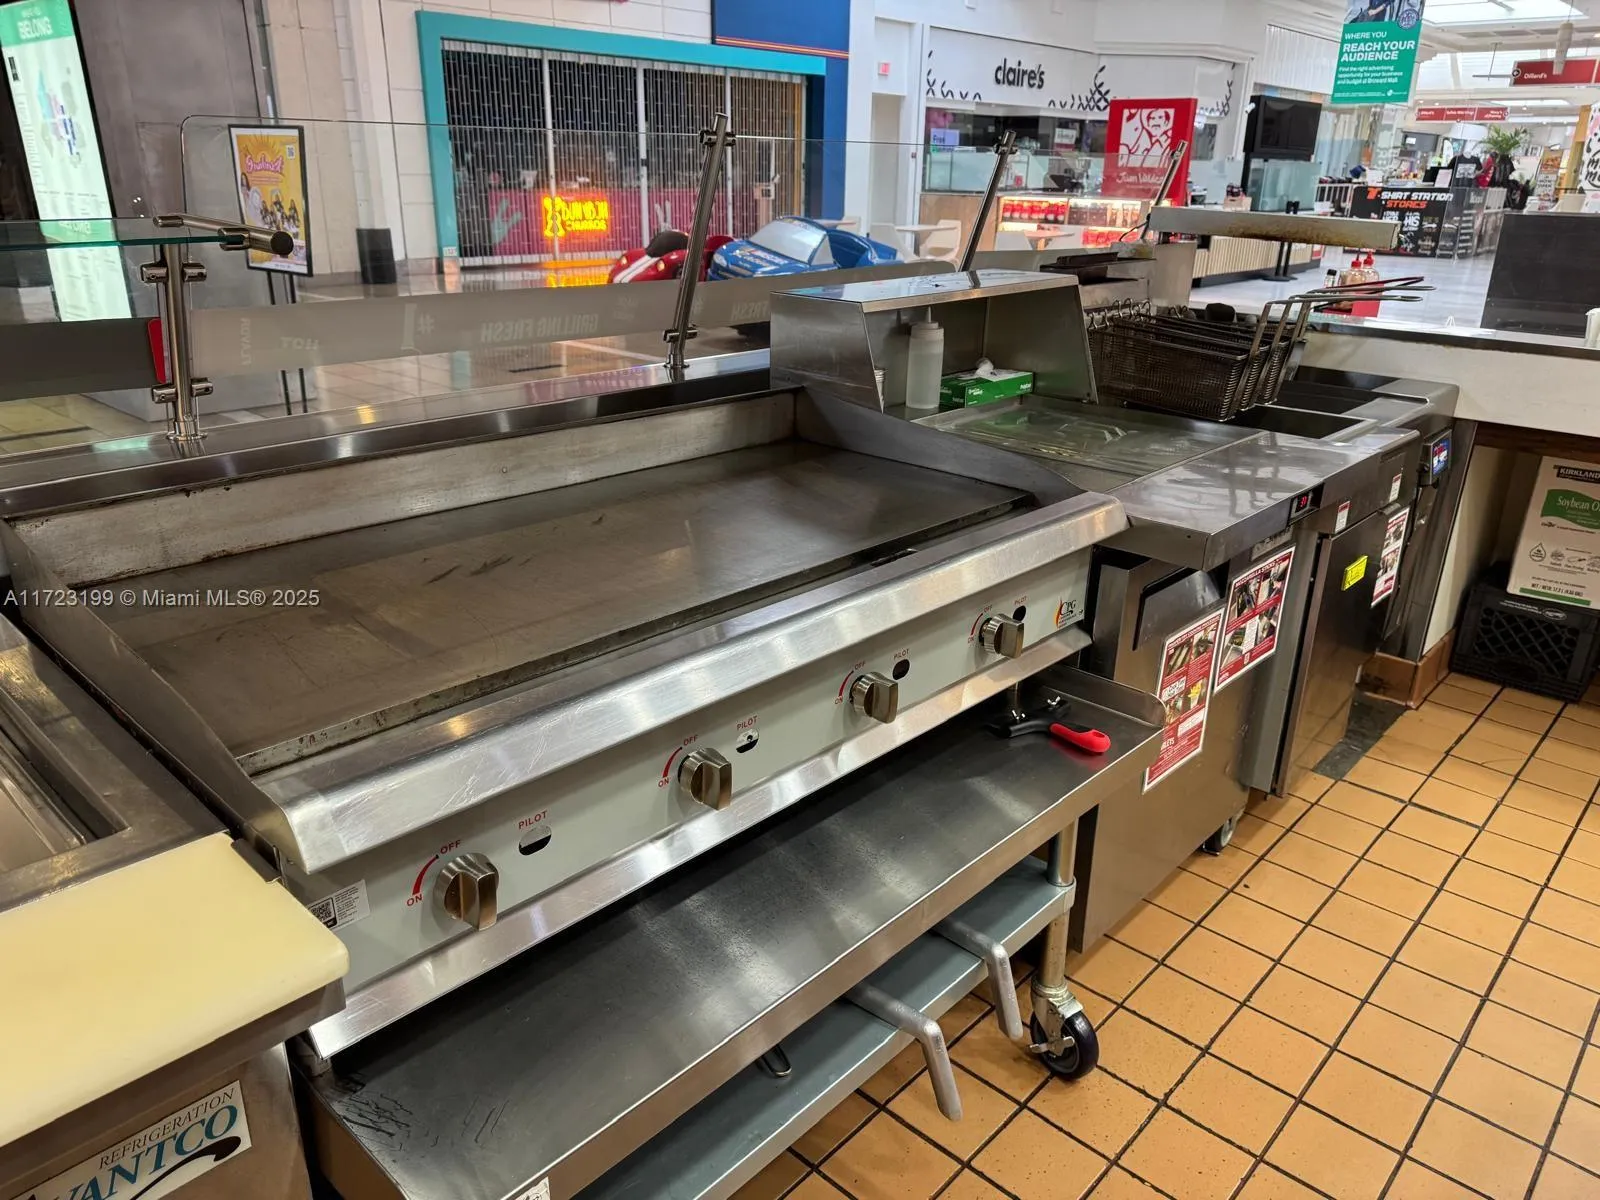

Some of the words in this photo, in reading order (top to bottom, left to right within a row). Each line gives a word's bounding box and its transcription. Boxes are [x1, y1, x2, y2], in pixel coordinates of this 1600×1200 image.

[1343, 42, 1381, 52] REACH
[1383, 40, 1415, 50] YOUR
[1341, 51, 1399, 62] AUDIENCE
[995, 57, 1045, 90] claire's
[1411, 191, 1454, 201] STATION
[1556, 495, 1590, 510] Soybean
[1061, 599, 1077, 616] CPG
[893, 648, 910, 660] PILOT
[854, 661, 866, 670] OFF
[736, 715, 758, 730] PILOT
[683, 734, 699, 746] OFF
[658, 777, 670, 788] ON
[518, 810, 548, 829] PILOT
[440, 839, 462, 854] OFF
[406, 893, 423, 907] ON
[99, 1087, 235, 1169] REFRIGERATION
